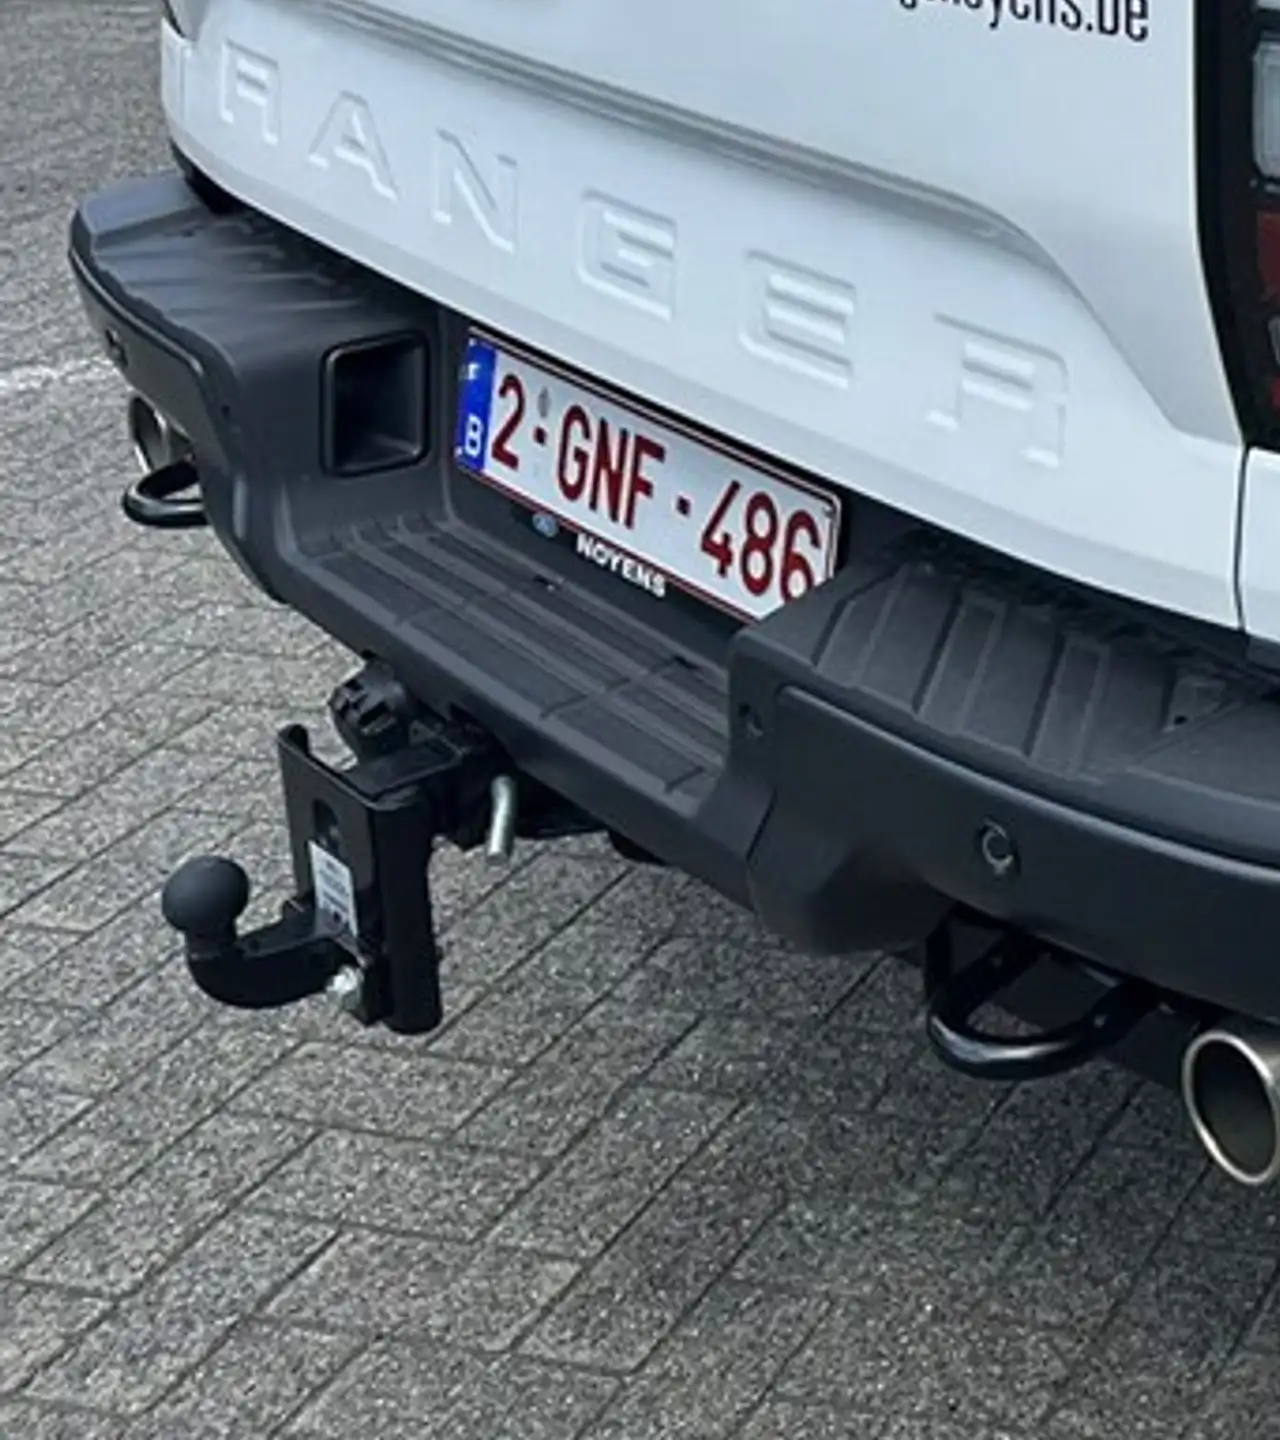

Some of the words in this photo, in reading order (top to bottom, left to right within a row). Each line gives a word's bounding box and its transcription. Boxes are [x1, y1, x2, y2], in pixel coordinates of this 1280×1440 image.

[217, 38, 1071, 468] RANGER
[464, 416, 485, 457] B
[576, 532, 668, 599] NOYENS
